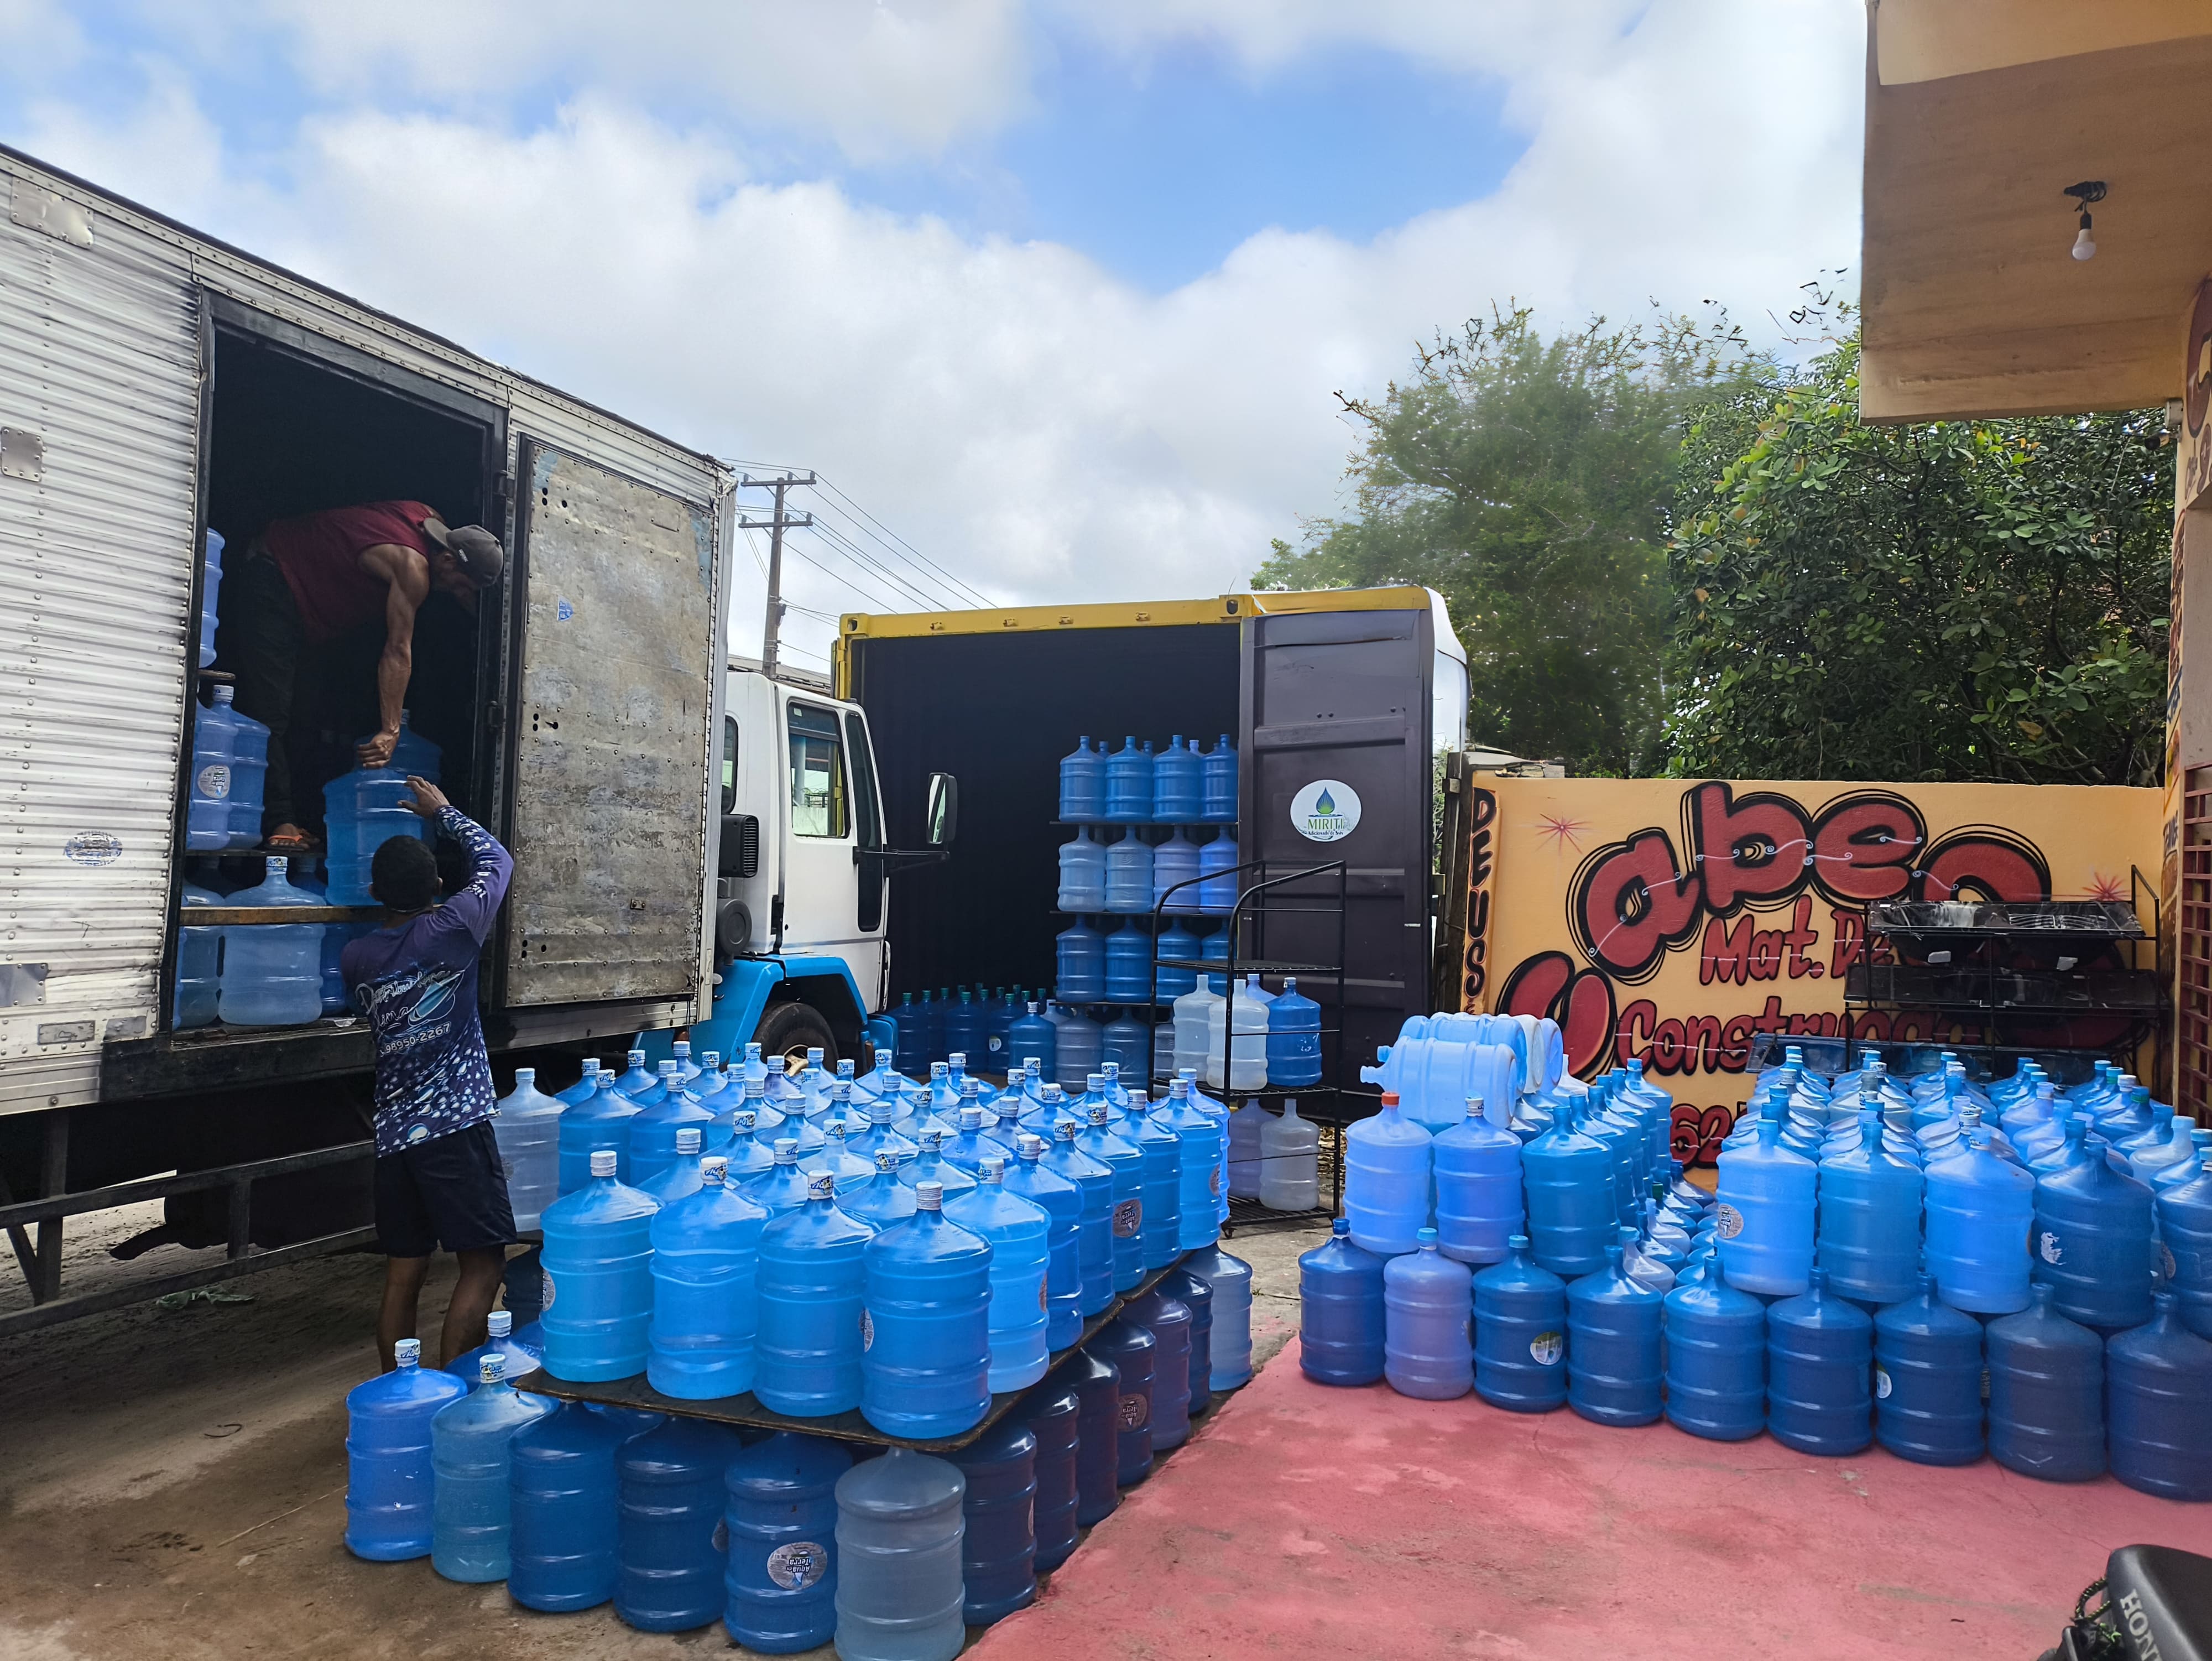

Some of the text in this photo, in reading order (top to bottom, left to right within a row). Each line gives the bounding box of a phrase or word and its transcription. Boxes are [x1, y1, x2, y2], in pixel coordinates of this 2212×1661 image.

[1308, 818, 1343, 830] MIRITI
[1464, 787, 1496, 998] DEUS
[1699, 894, 1824, 986] Mat.
[385, 1022, 452, 1054] 98950-2267
[789, 1557, 810, 1566] Terra
